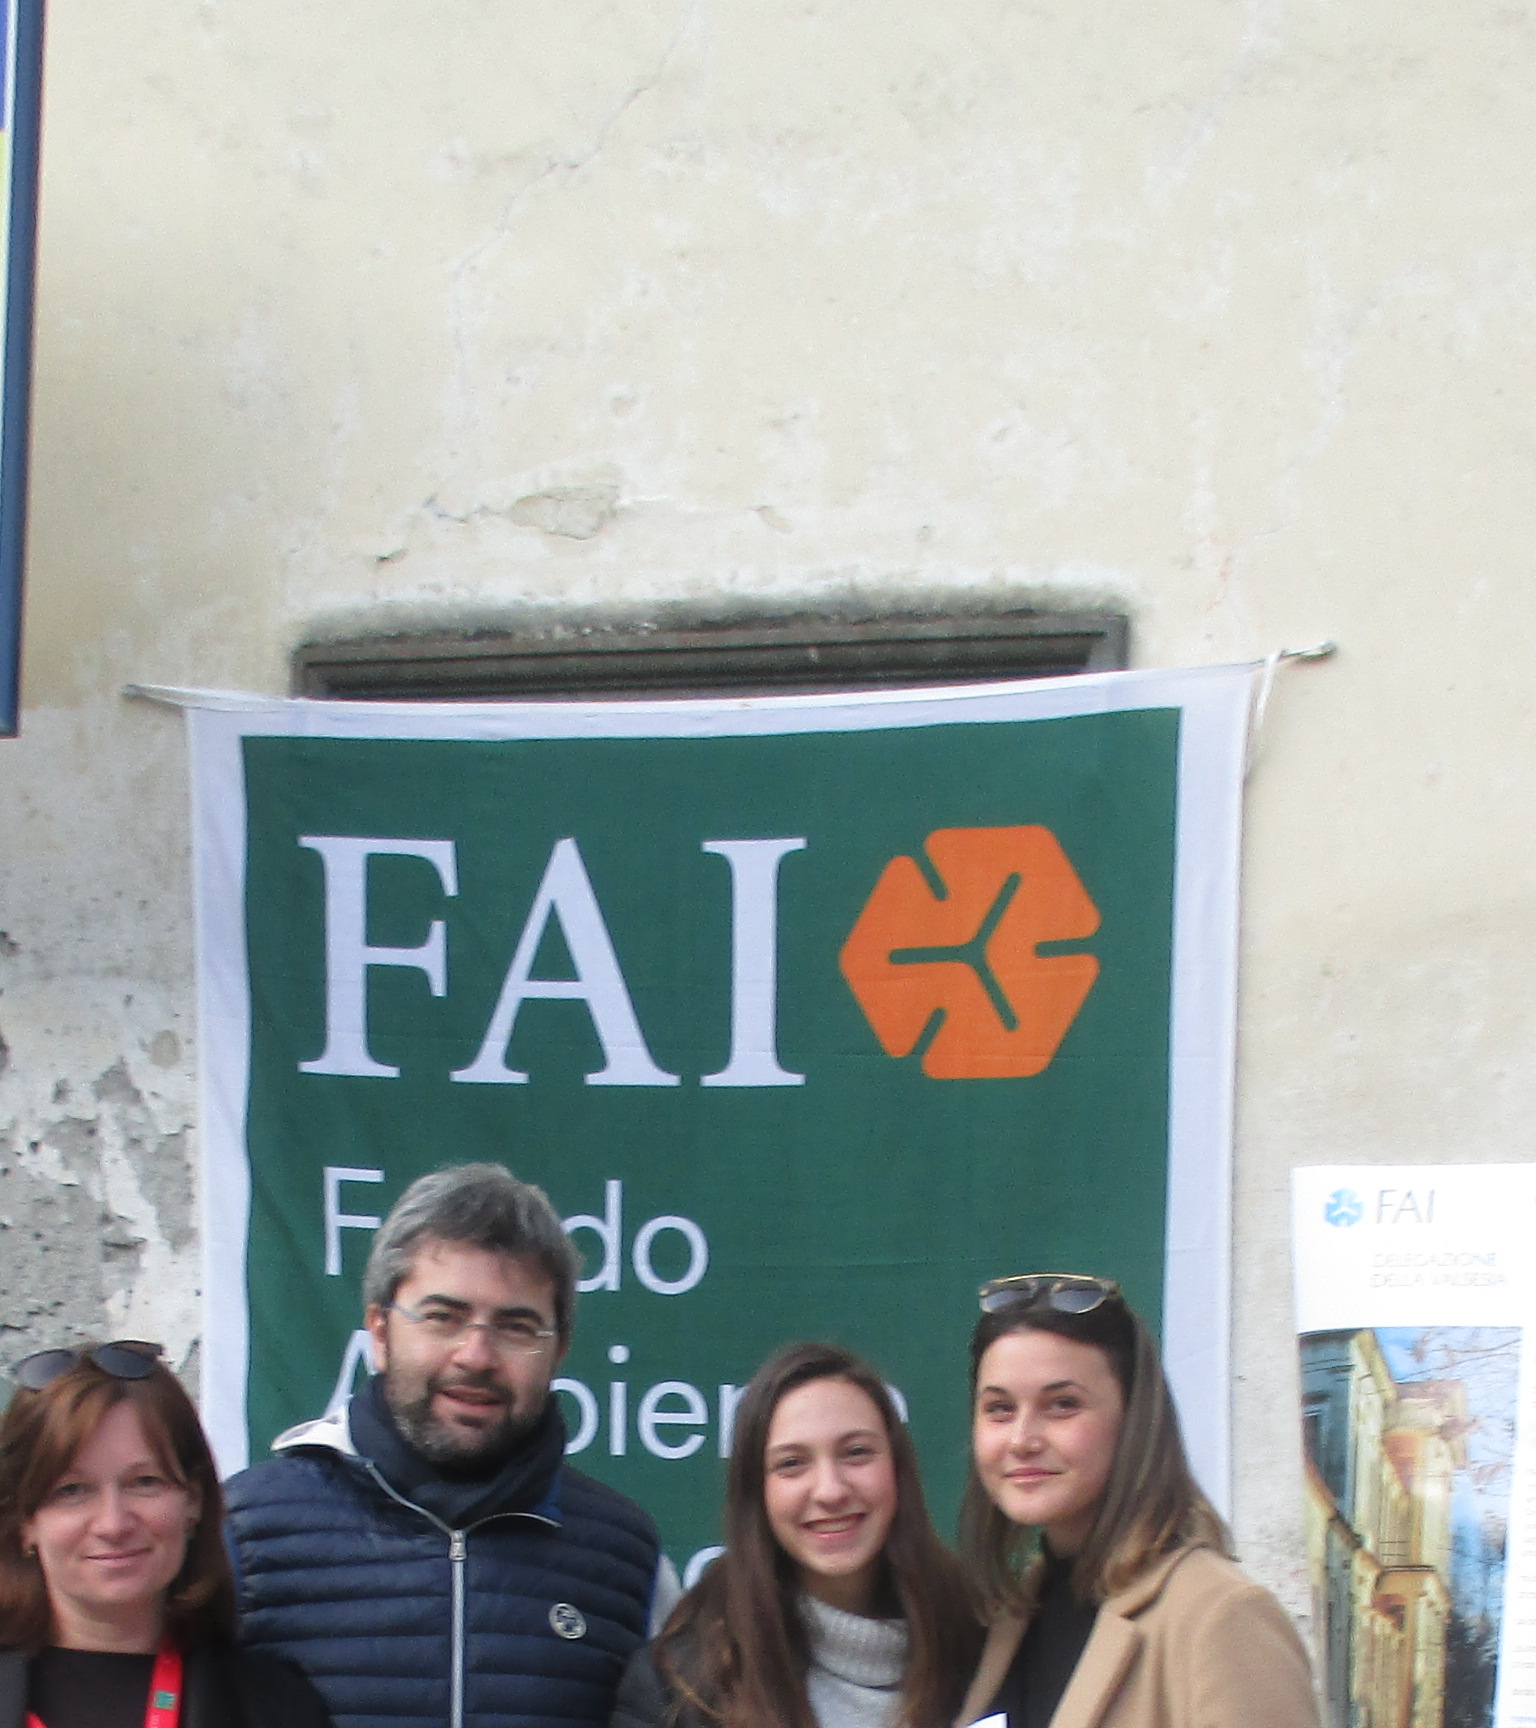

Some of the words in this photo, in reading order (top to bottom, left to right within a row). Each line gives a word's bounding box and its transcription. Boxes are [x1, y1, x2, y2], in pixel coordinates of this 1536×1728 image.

[297, 836, 807, 1087] FAI
[324, 1167, 709, 1295] Fdo
[1376, 1189, 1435, 1224] FAI
